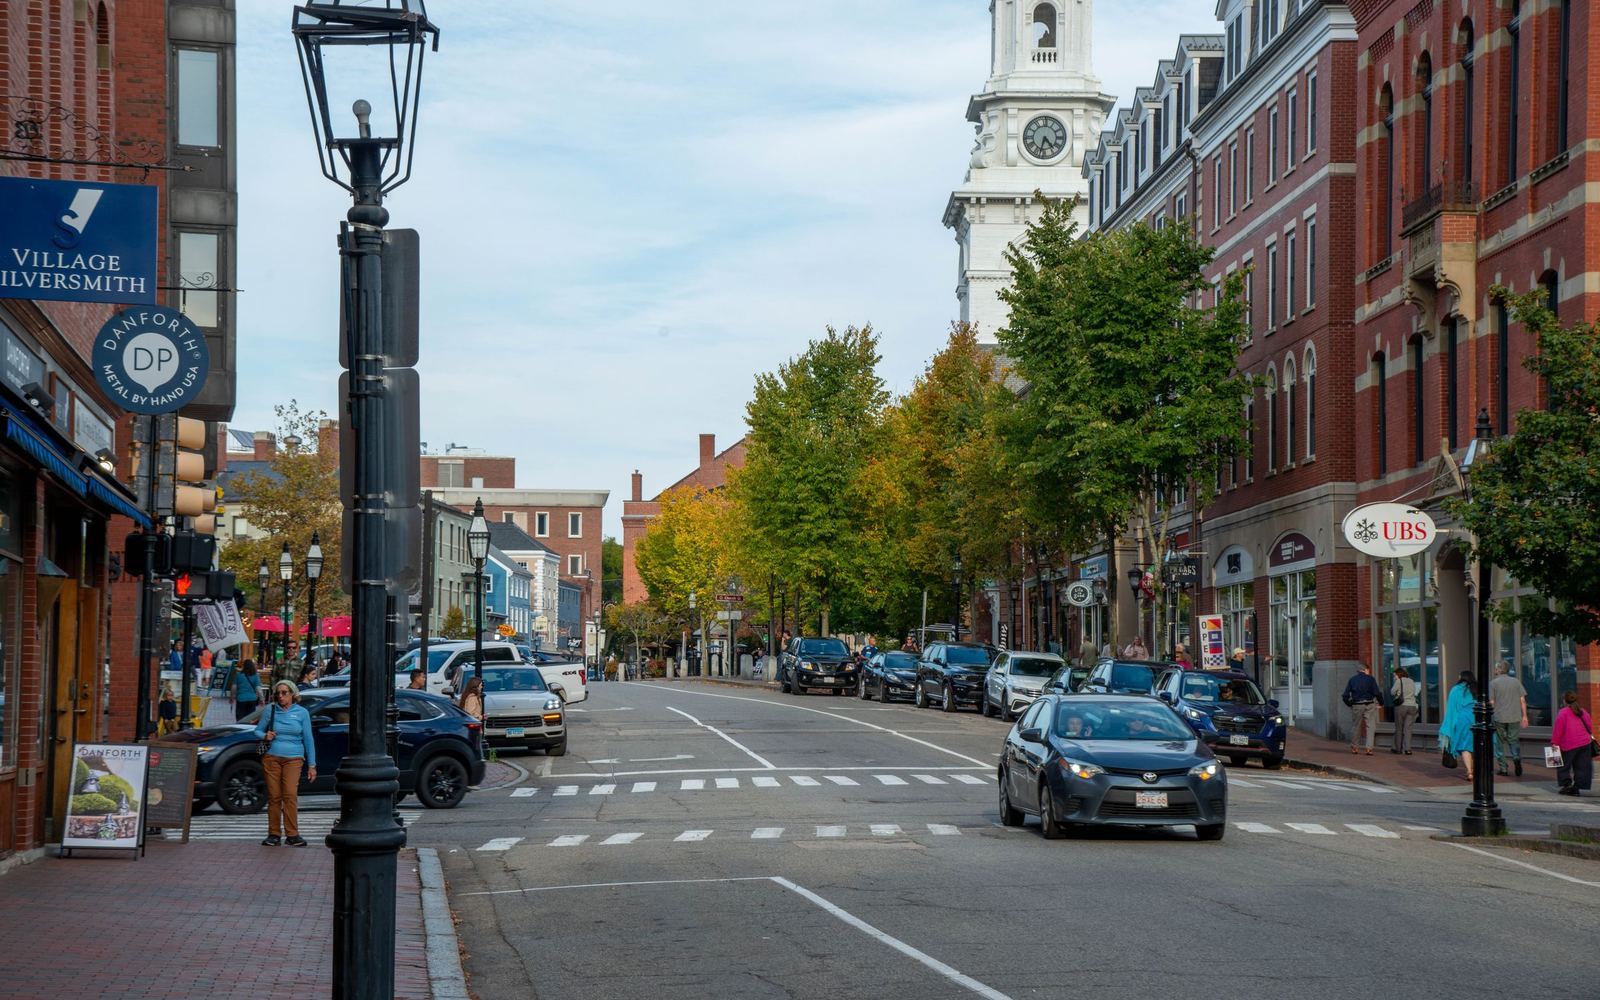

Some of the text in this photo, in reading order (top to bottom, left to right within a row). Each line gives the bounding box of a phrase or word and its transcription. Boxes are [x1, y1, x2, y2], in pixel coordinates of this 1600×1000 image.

[12, 248, 121, 271] VILLAGE
[133, 347, 173, 372] DP
[103, 364, 200, 406] METAL BY HAND USA
[1382, 521, 1427, 541] UBS
[80, 748, 141, 758] DANFORTH
